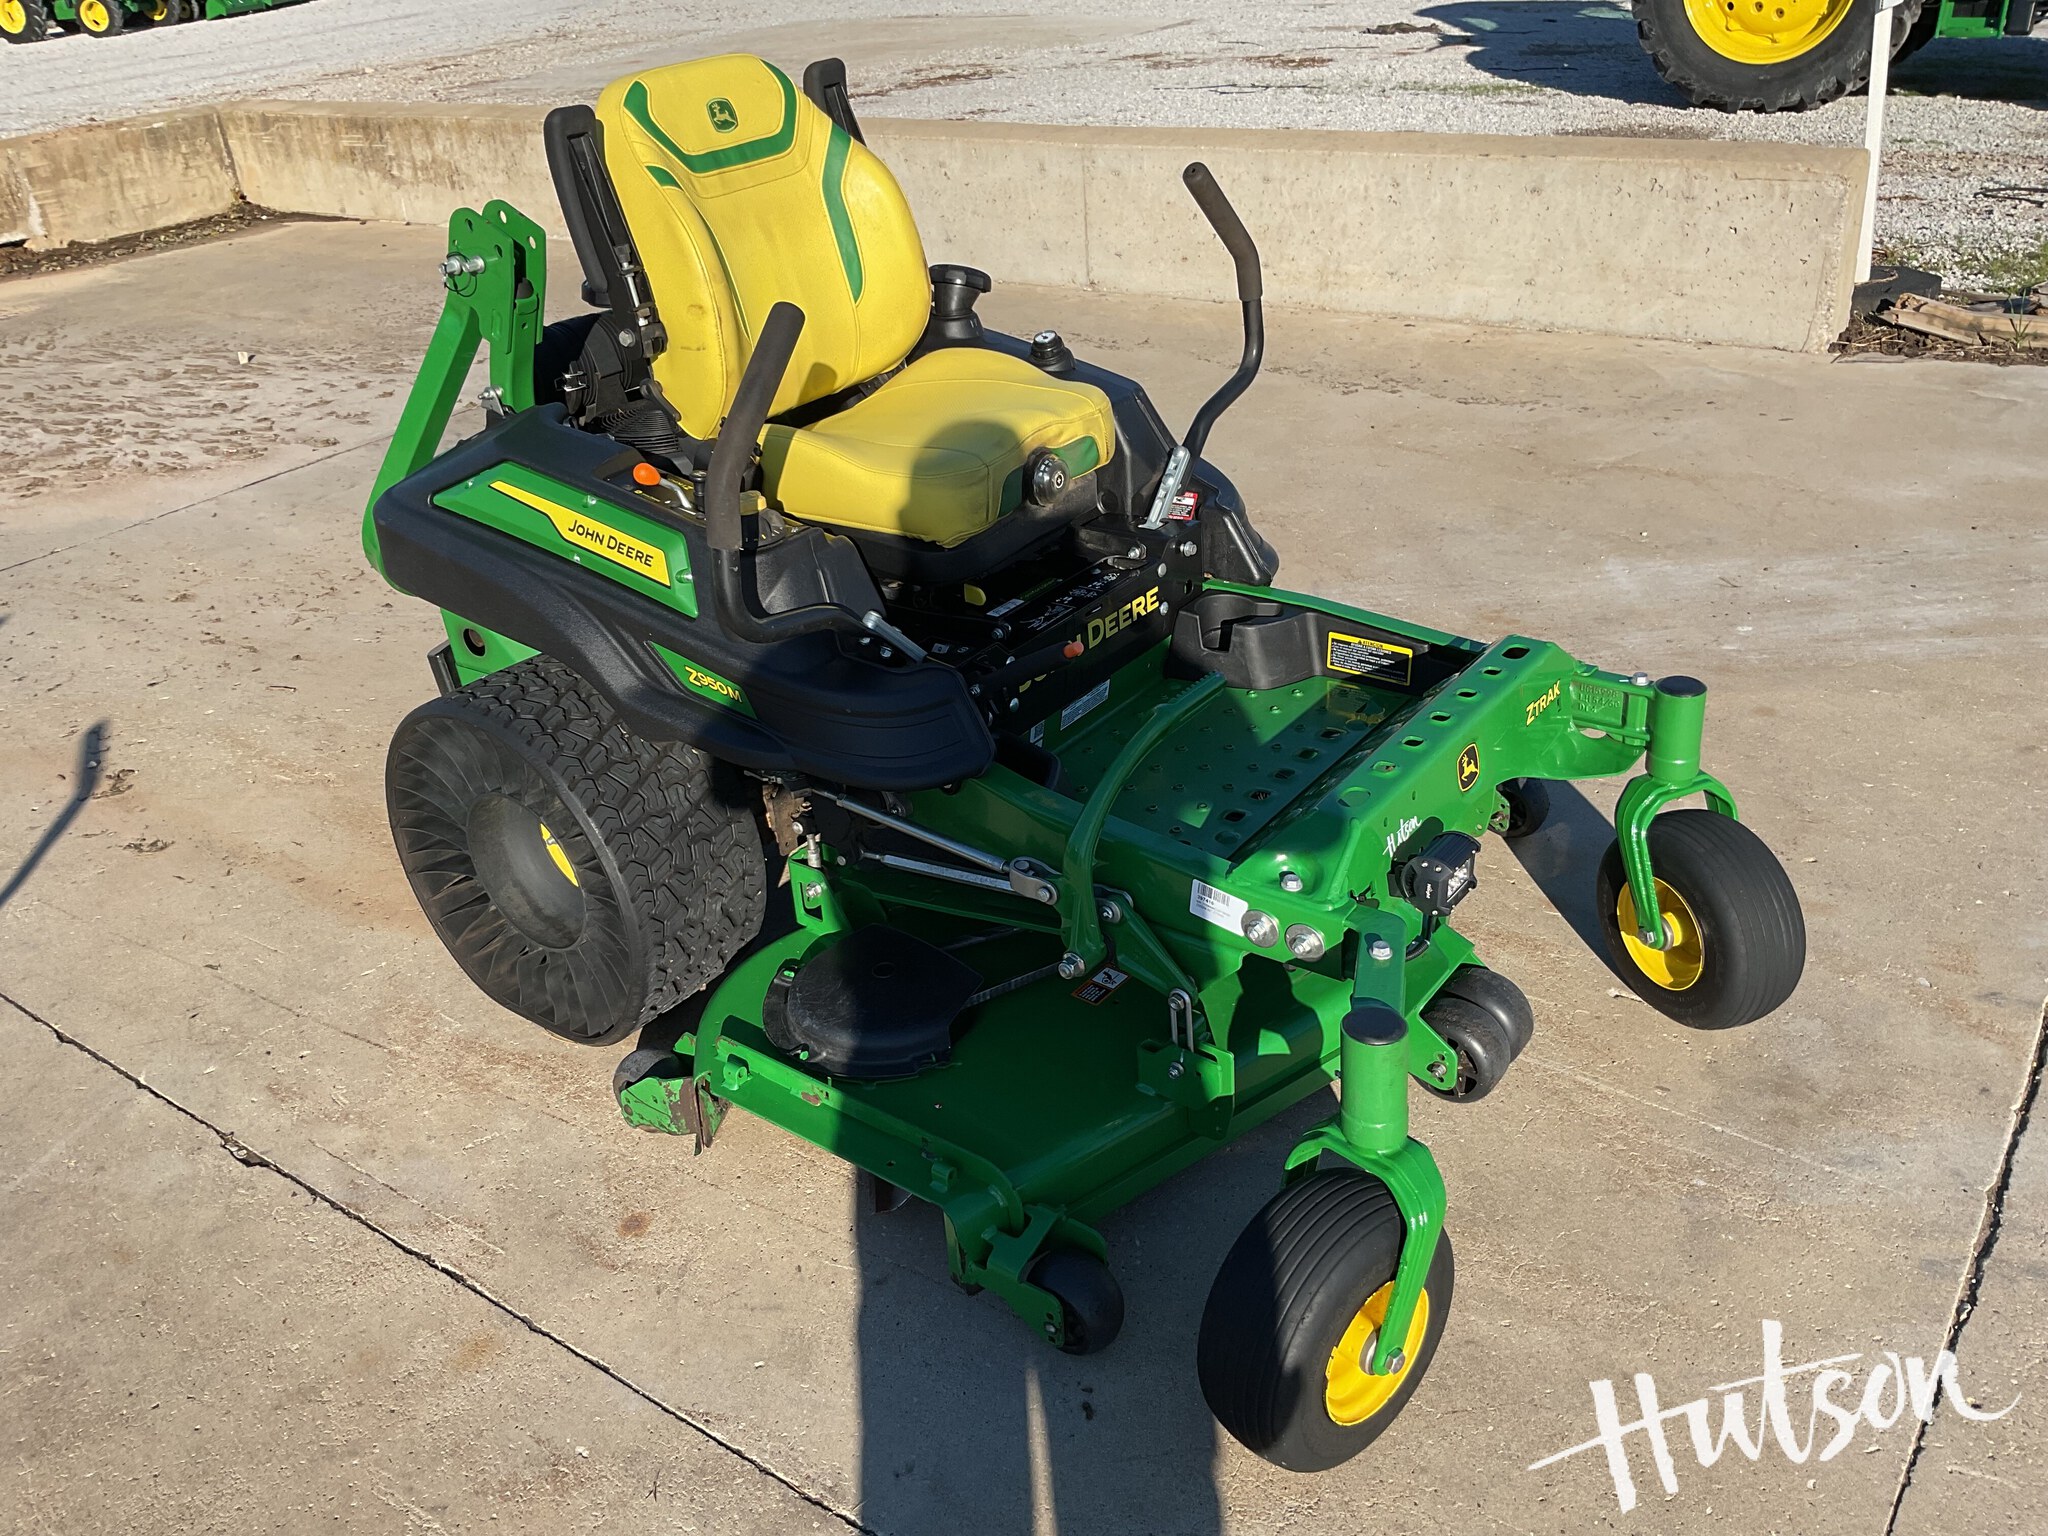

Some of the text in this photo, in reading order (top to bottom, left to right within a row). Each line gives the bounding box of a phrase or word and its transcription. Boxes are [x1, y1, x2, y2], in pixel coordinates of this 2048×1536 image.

[568, 519, 654, 568] JOHN DEERE
[1087, 586, 1160, 649] DEERE
[685, 666, 743, 703] Z950M
[1526, 680, 1561, 726] ZTRAK
